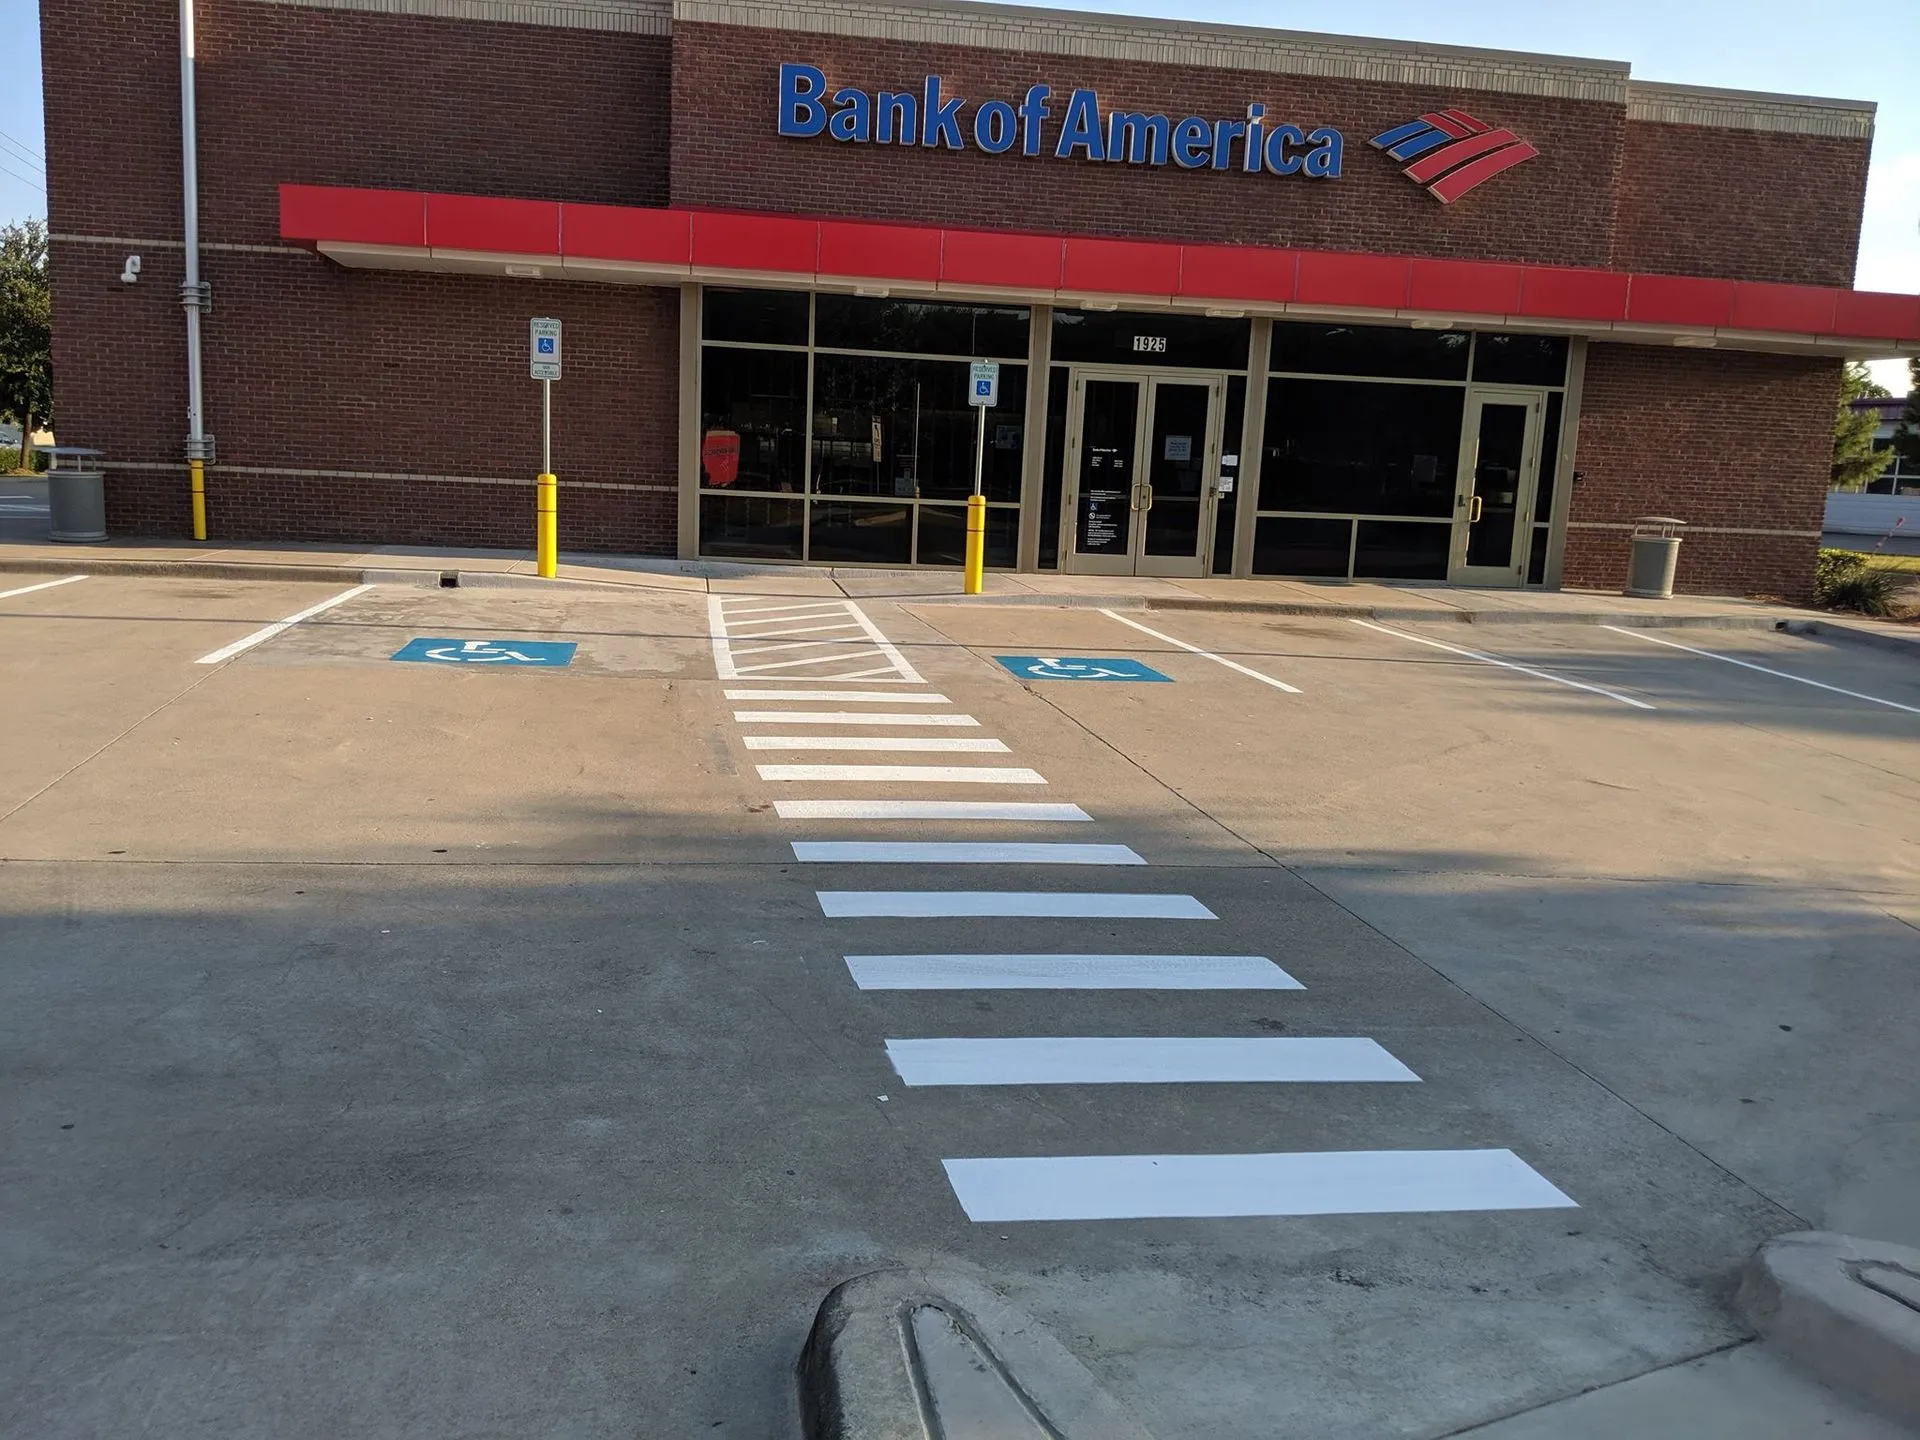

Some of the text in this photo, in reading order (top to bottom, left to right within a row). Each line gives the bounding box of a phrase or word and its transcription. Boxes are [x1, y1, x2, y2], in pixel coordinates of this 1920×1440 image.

[777, 63, 1344, 178] Bank of America
[1135, 337, 1165, 351] 1925
